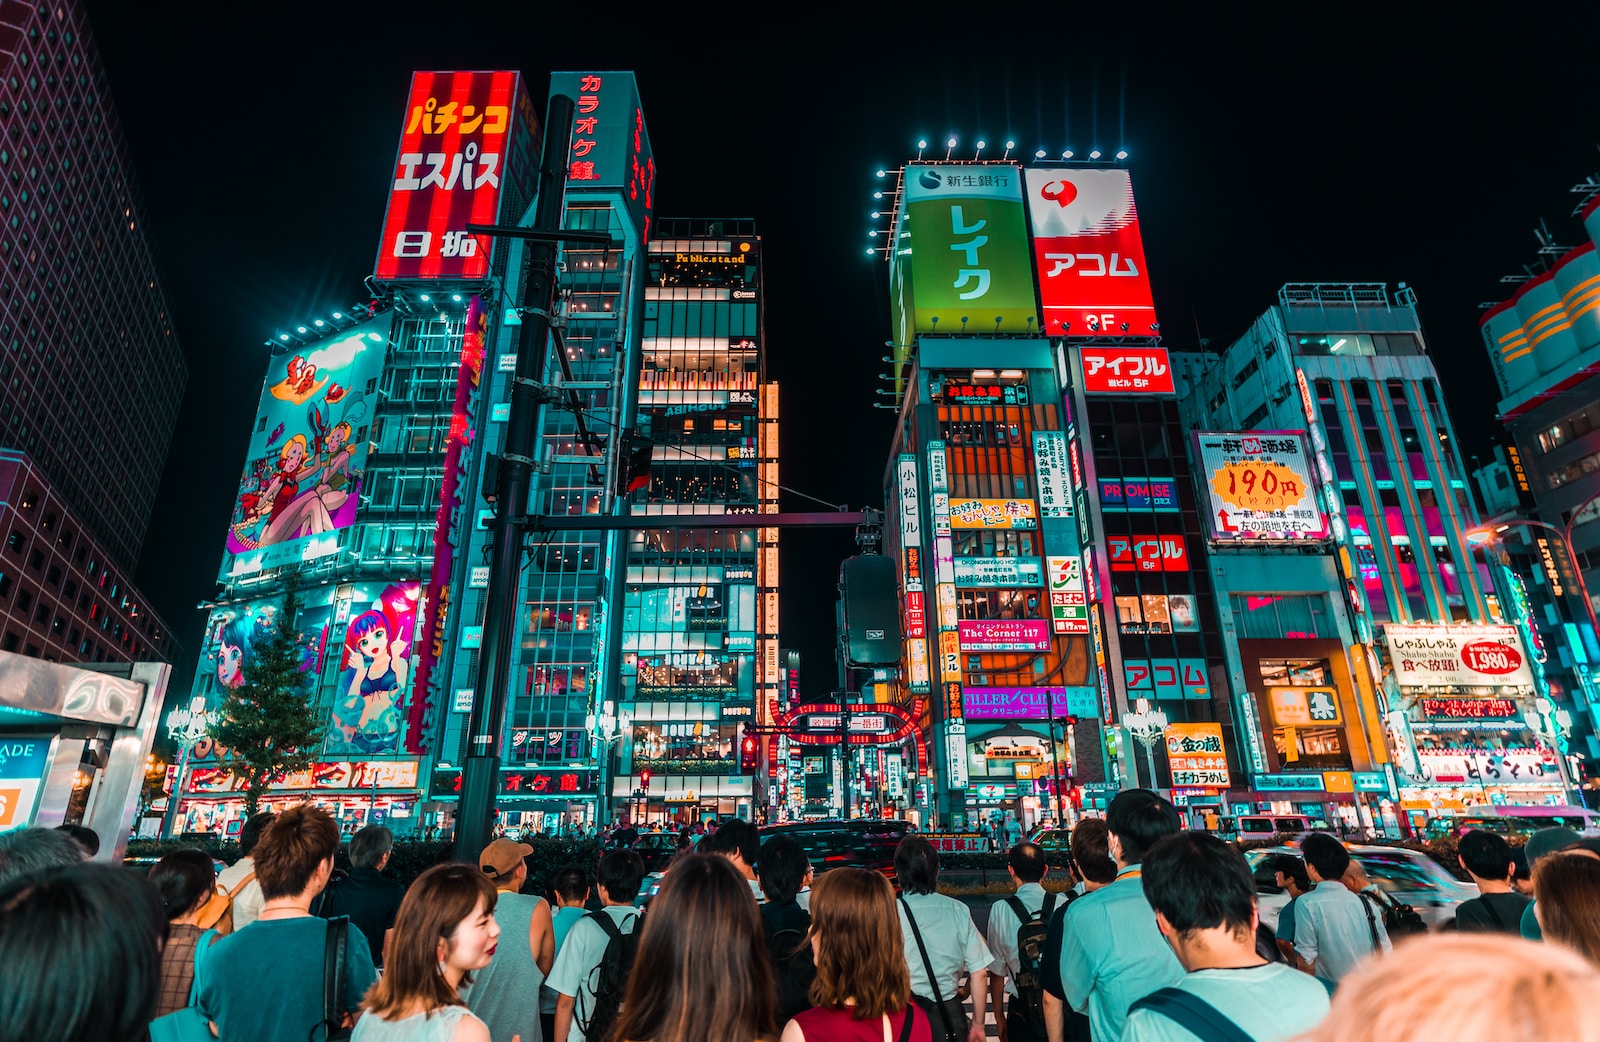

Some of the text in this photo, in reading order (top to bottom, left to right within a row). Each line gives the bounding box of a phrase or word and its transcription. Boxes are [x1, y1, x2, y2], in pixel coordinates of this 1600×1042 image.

[405, 97, 509, 134] パチンコ
[570, 75, 601, 180] カラオケ館
[393, 142, 499, 191] エスパス
[946, 175, 1008, 188] 新生銀行
[950, 205, 992, 300] レイク
[1044, 252, 1139, 278] アコム
[1085, 313, 1115, 332] 3F
[1084, 356, 1166, 376] アイフル
[1228, 469, 1298, 497] 190円
[1103, 484, 1171, 498] PROMISE
[903, 469, 918, 533] 小松ビル
[1143, 497, 1171, 505] プロミス
[950, 501, 982, 516] お好み
[1004, 501, 1031, 516] 焼き
[983, 513, 1005, 526] たこ
[1240, 521, 1311, 532] 左の路地を右へ
[1109, 540, 1183, 559] アイフル
[956, 574, 1018, 583] お好み焼き本陣
[1053, 593, 1083, 604] たばこ
[1062, 607, 1076, 617] 酒
[912, 628, 922, 636] 4F
[963, 629, 1039, 637] The Corner 117
[1037, 641, 1048, 649] 4F
[1393, 637, 1458, 649] しゃぶしゃぶ
[1401, 659, 1460, 672] 食べ放題!
[1468, 652, 1509, 671] 1,980
[1126, 665, 1206, 687] アコム
[964, 693, 1010, 706] FILLER
[811, 719, 883, 729] 歌舞伎一番街
[952, 725, 961, 733] 8F
[513, 731, 563, 747] ダーツ
[1181, 736, 1222, 752] 金の蔵
[1180, 771, 1229, 784] チカラめし
